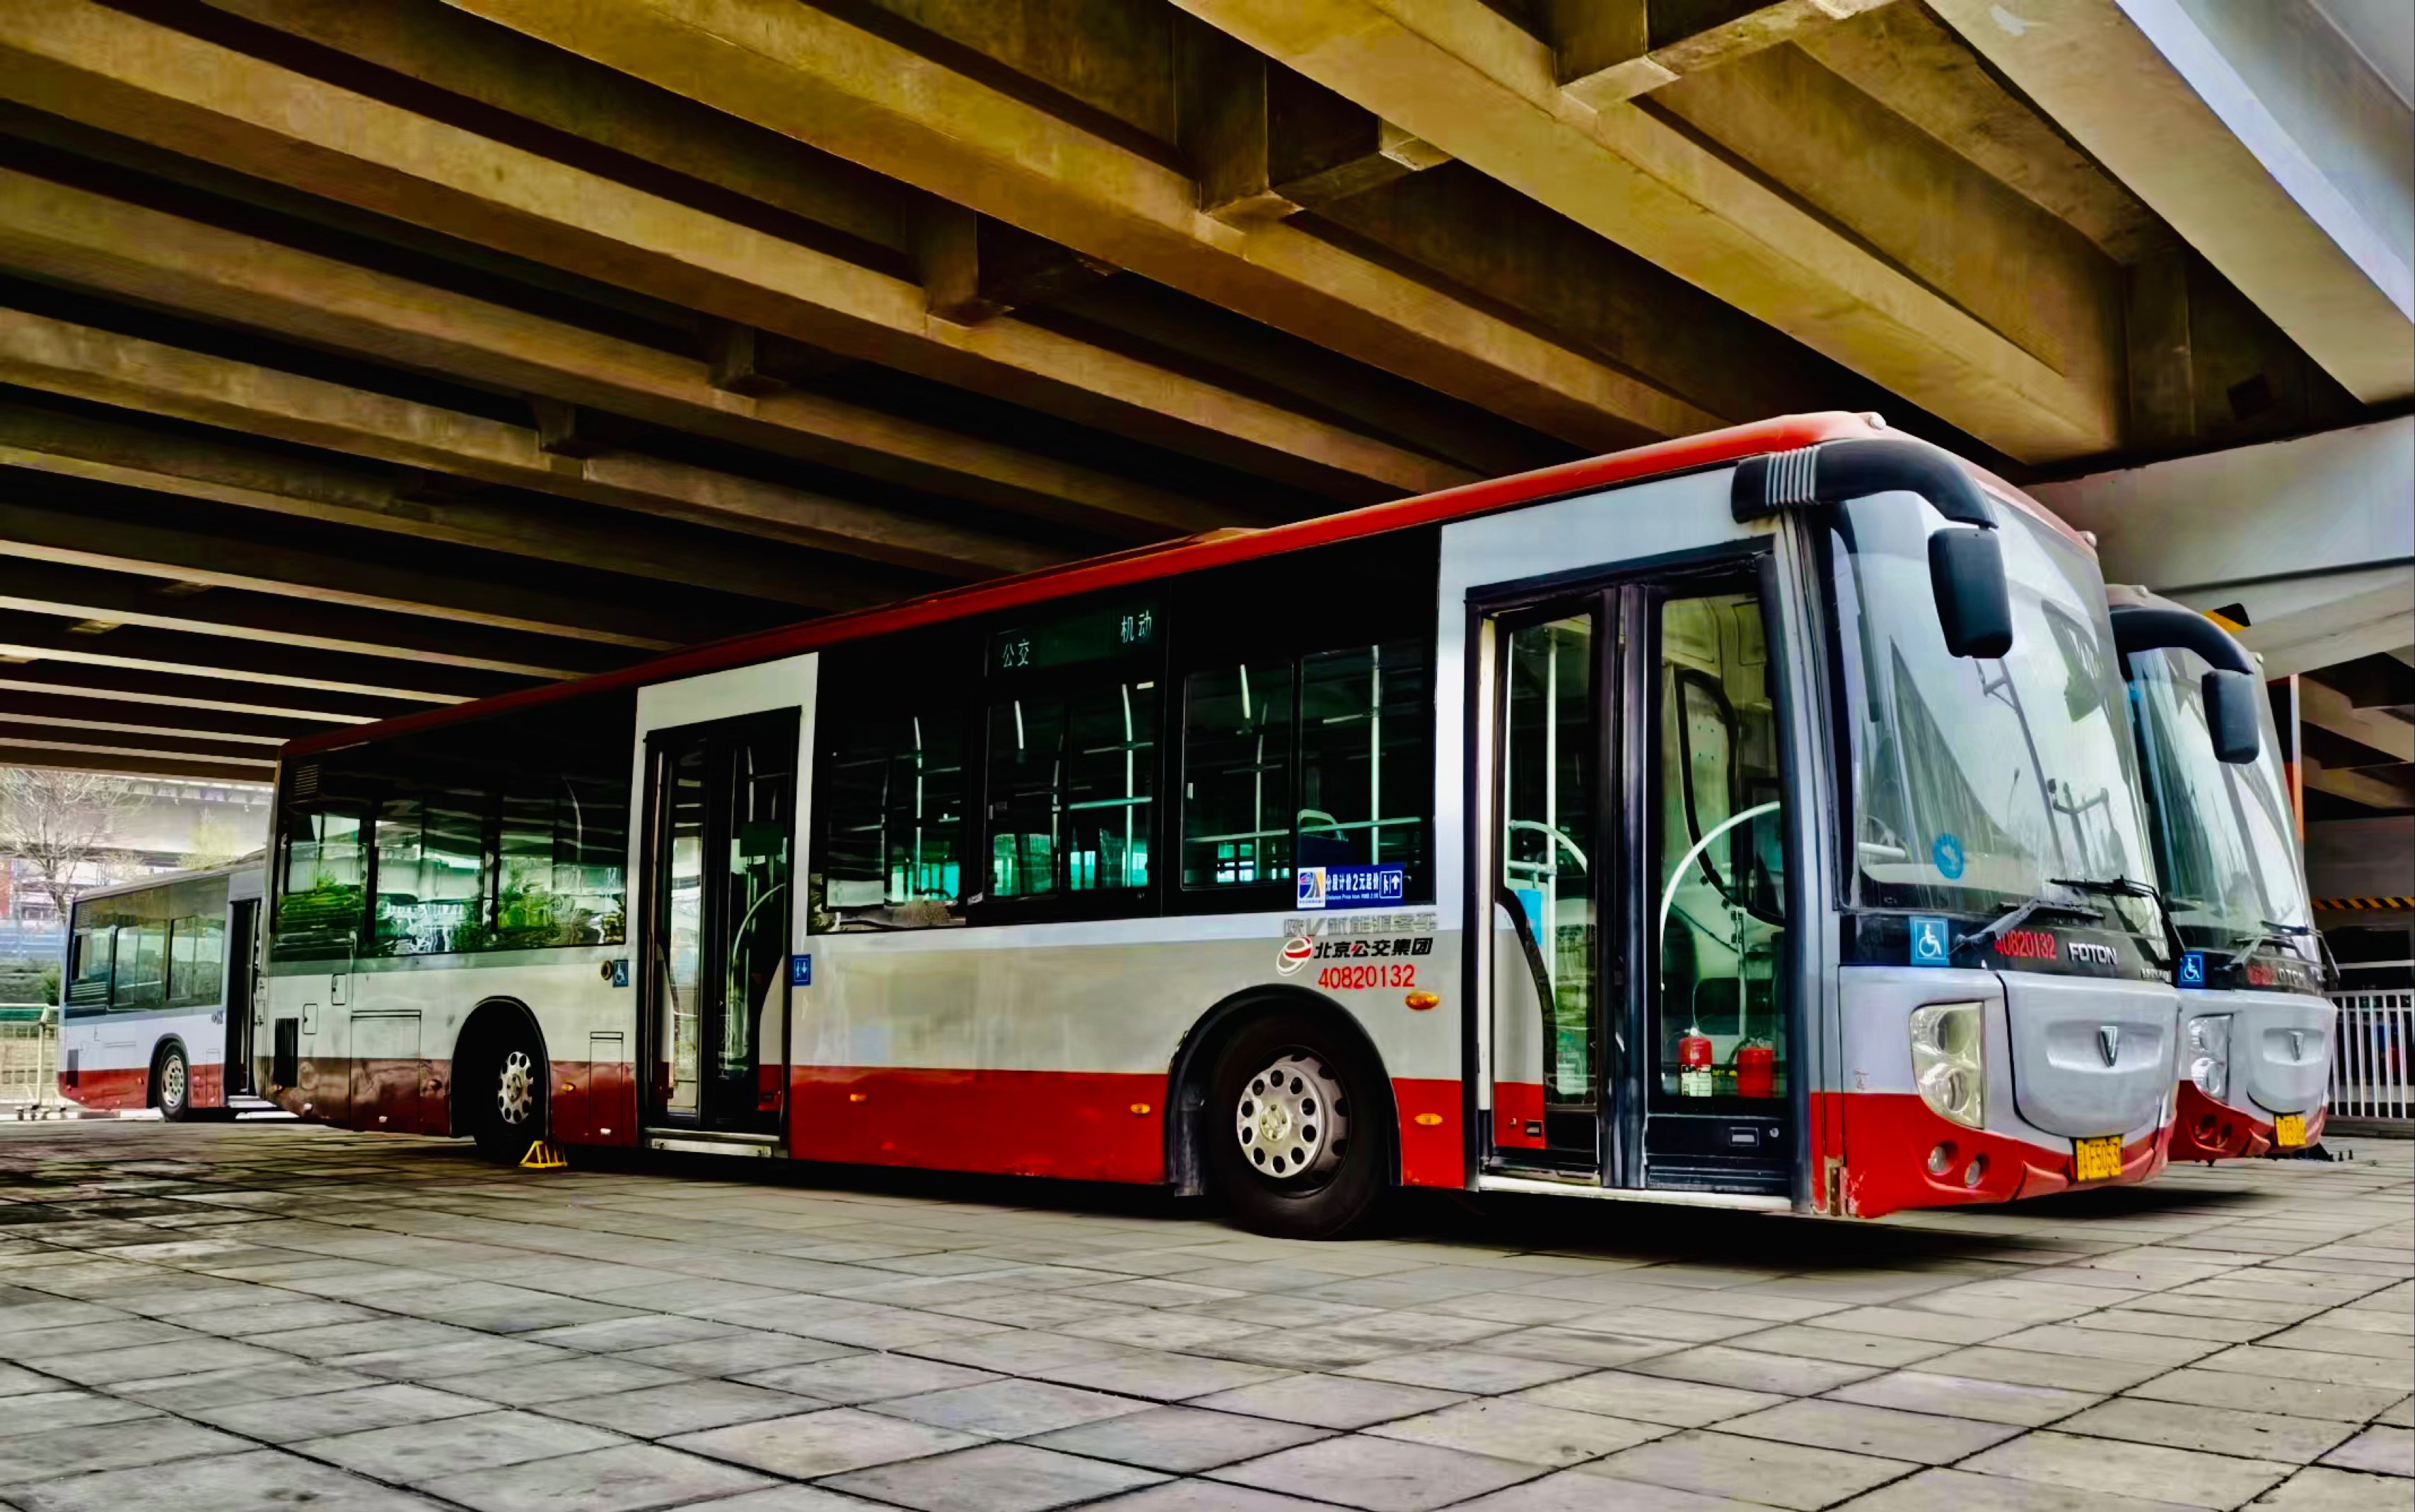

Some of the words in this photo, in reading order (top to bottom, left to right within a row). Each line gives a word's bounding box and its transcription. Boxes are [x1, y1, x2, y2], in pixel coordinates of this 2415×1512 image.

[1002, 638, 1030, 668] 公交
[1121, 610, 1152, 644] 机动
[1314, 938, 1433, 959] 北京公交集团
[1994, 929, 2057, 960] 40820132
[2068, 942, 2117, 965] FOTON
[1318, 964, 1415, 989] 40820132
